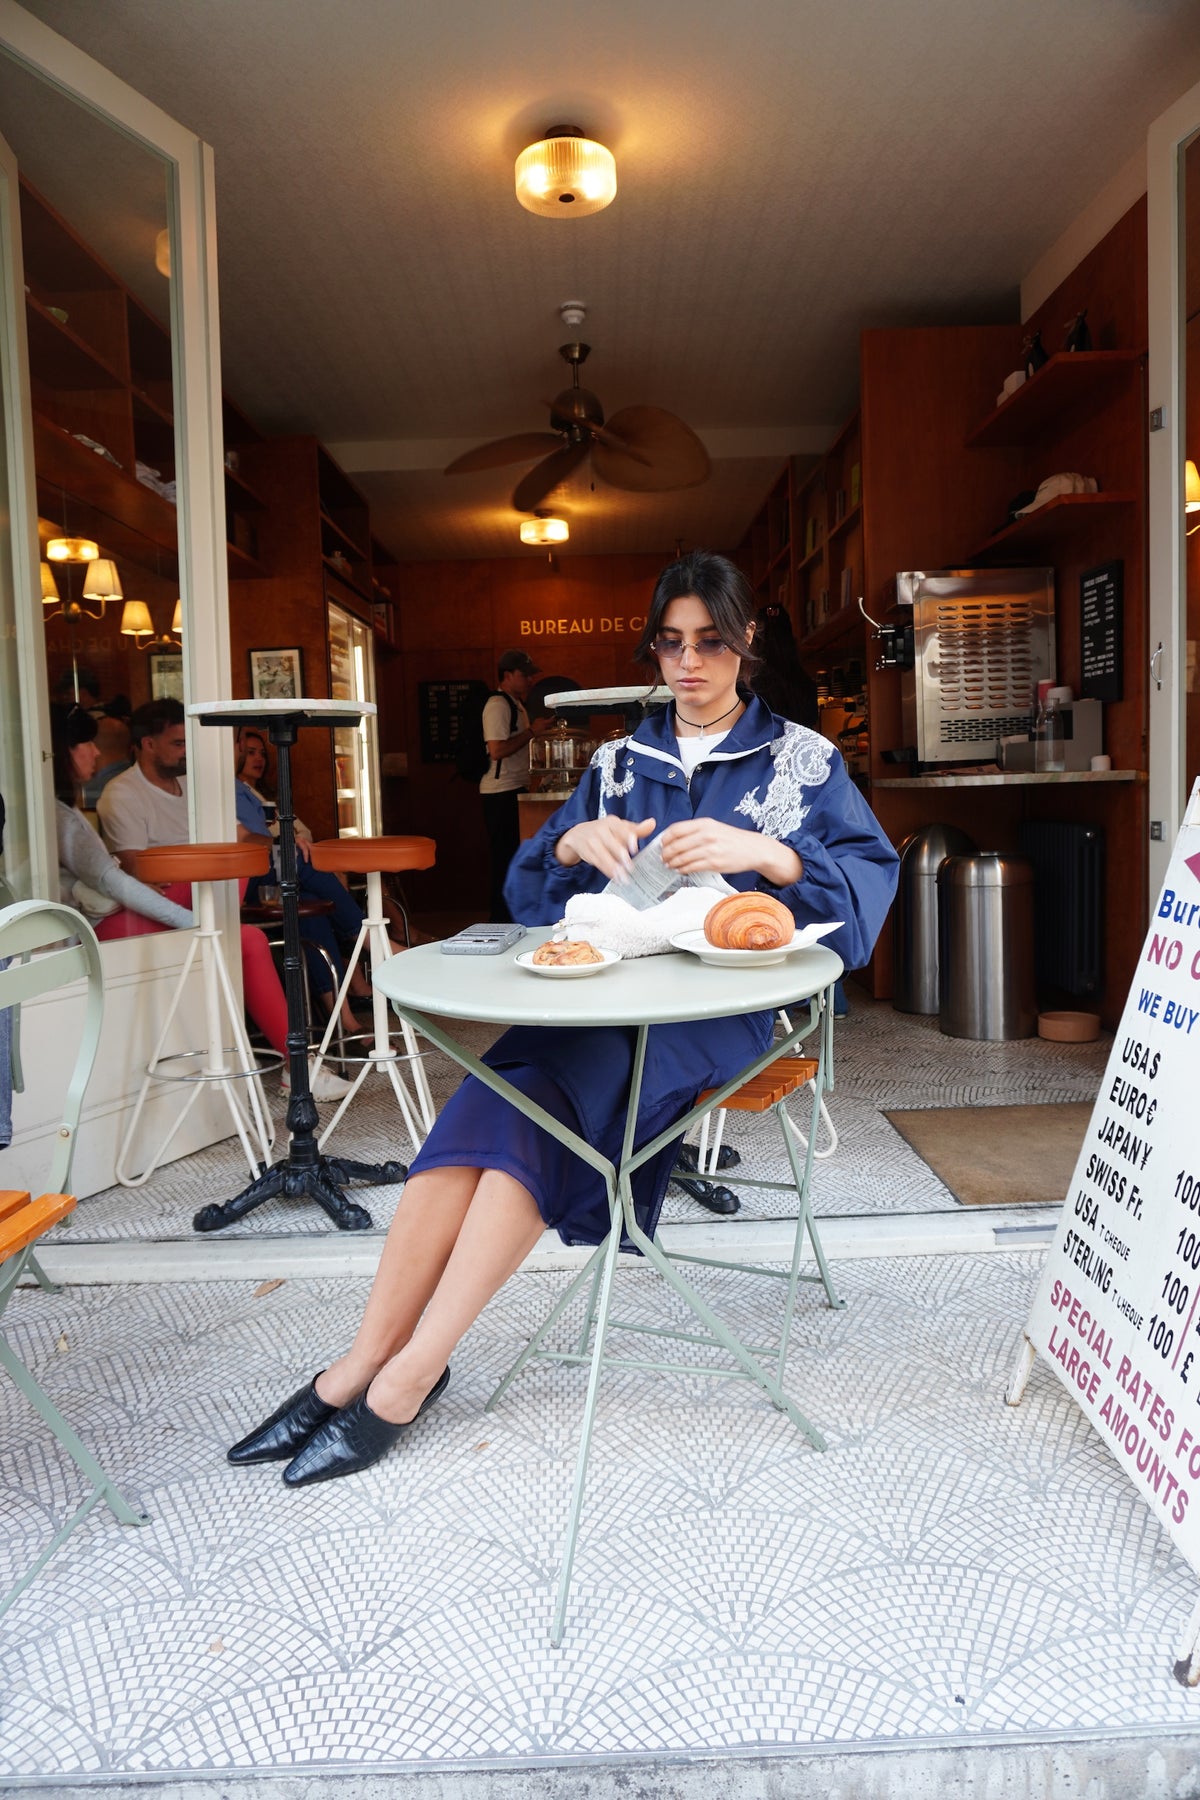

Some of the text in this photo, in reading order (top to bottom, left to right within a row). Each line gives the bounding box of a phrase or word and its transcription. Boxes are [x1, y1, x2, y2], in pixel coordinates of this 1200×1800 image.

[521, 618, 594, 635] BUREAU
[601, 617, 624, 632] DE
[1158, 889, 1200, 928] Bur
[1147, 933, 1183, 971] NO
[1138, 988, 1200, 1034] WE BUY
[1086, 1153, 1127, 1203] SWISS
[1126, 1185, 1143, 1221] Fr.
[1074, 1190, 1189, 1315] USA T CHEQUE 100
[1063, 1229, 1114, 1294] STERLING
[1111, 1289, 1118, 1302] T
[1147, 1314, 1174, 1359] 100
[1180, 1352, 1194, 1384] £
[1050, 1280, 1113, 1370] SPECIAL
[1116, 1354, 1175, 1441] RATES
[1048, 1325, 1189, 1524] LARGE AMOUNTS
